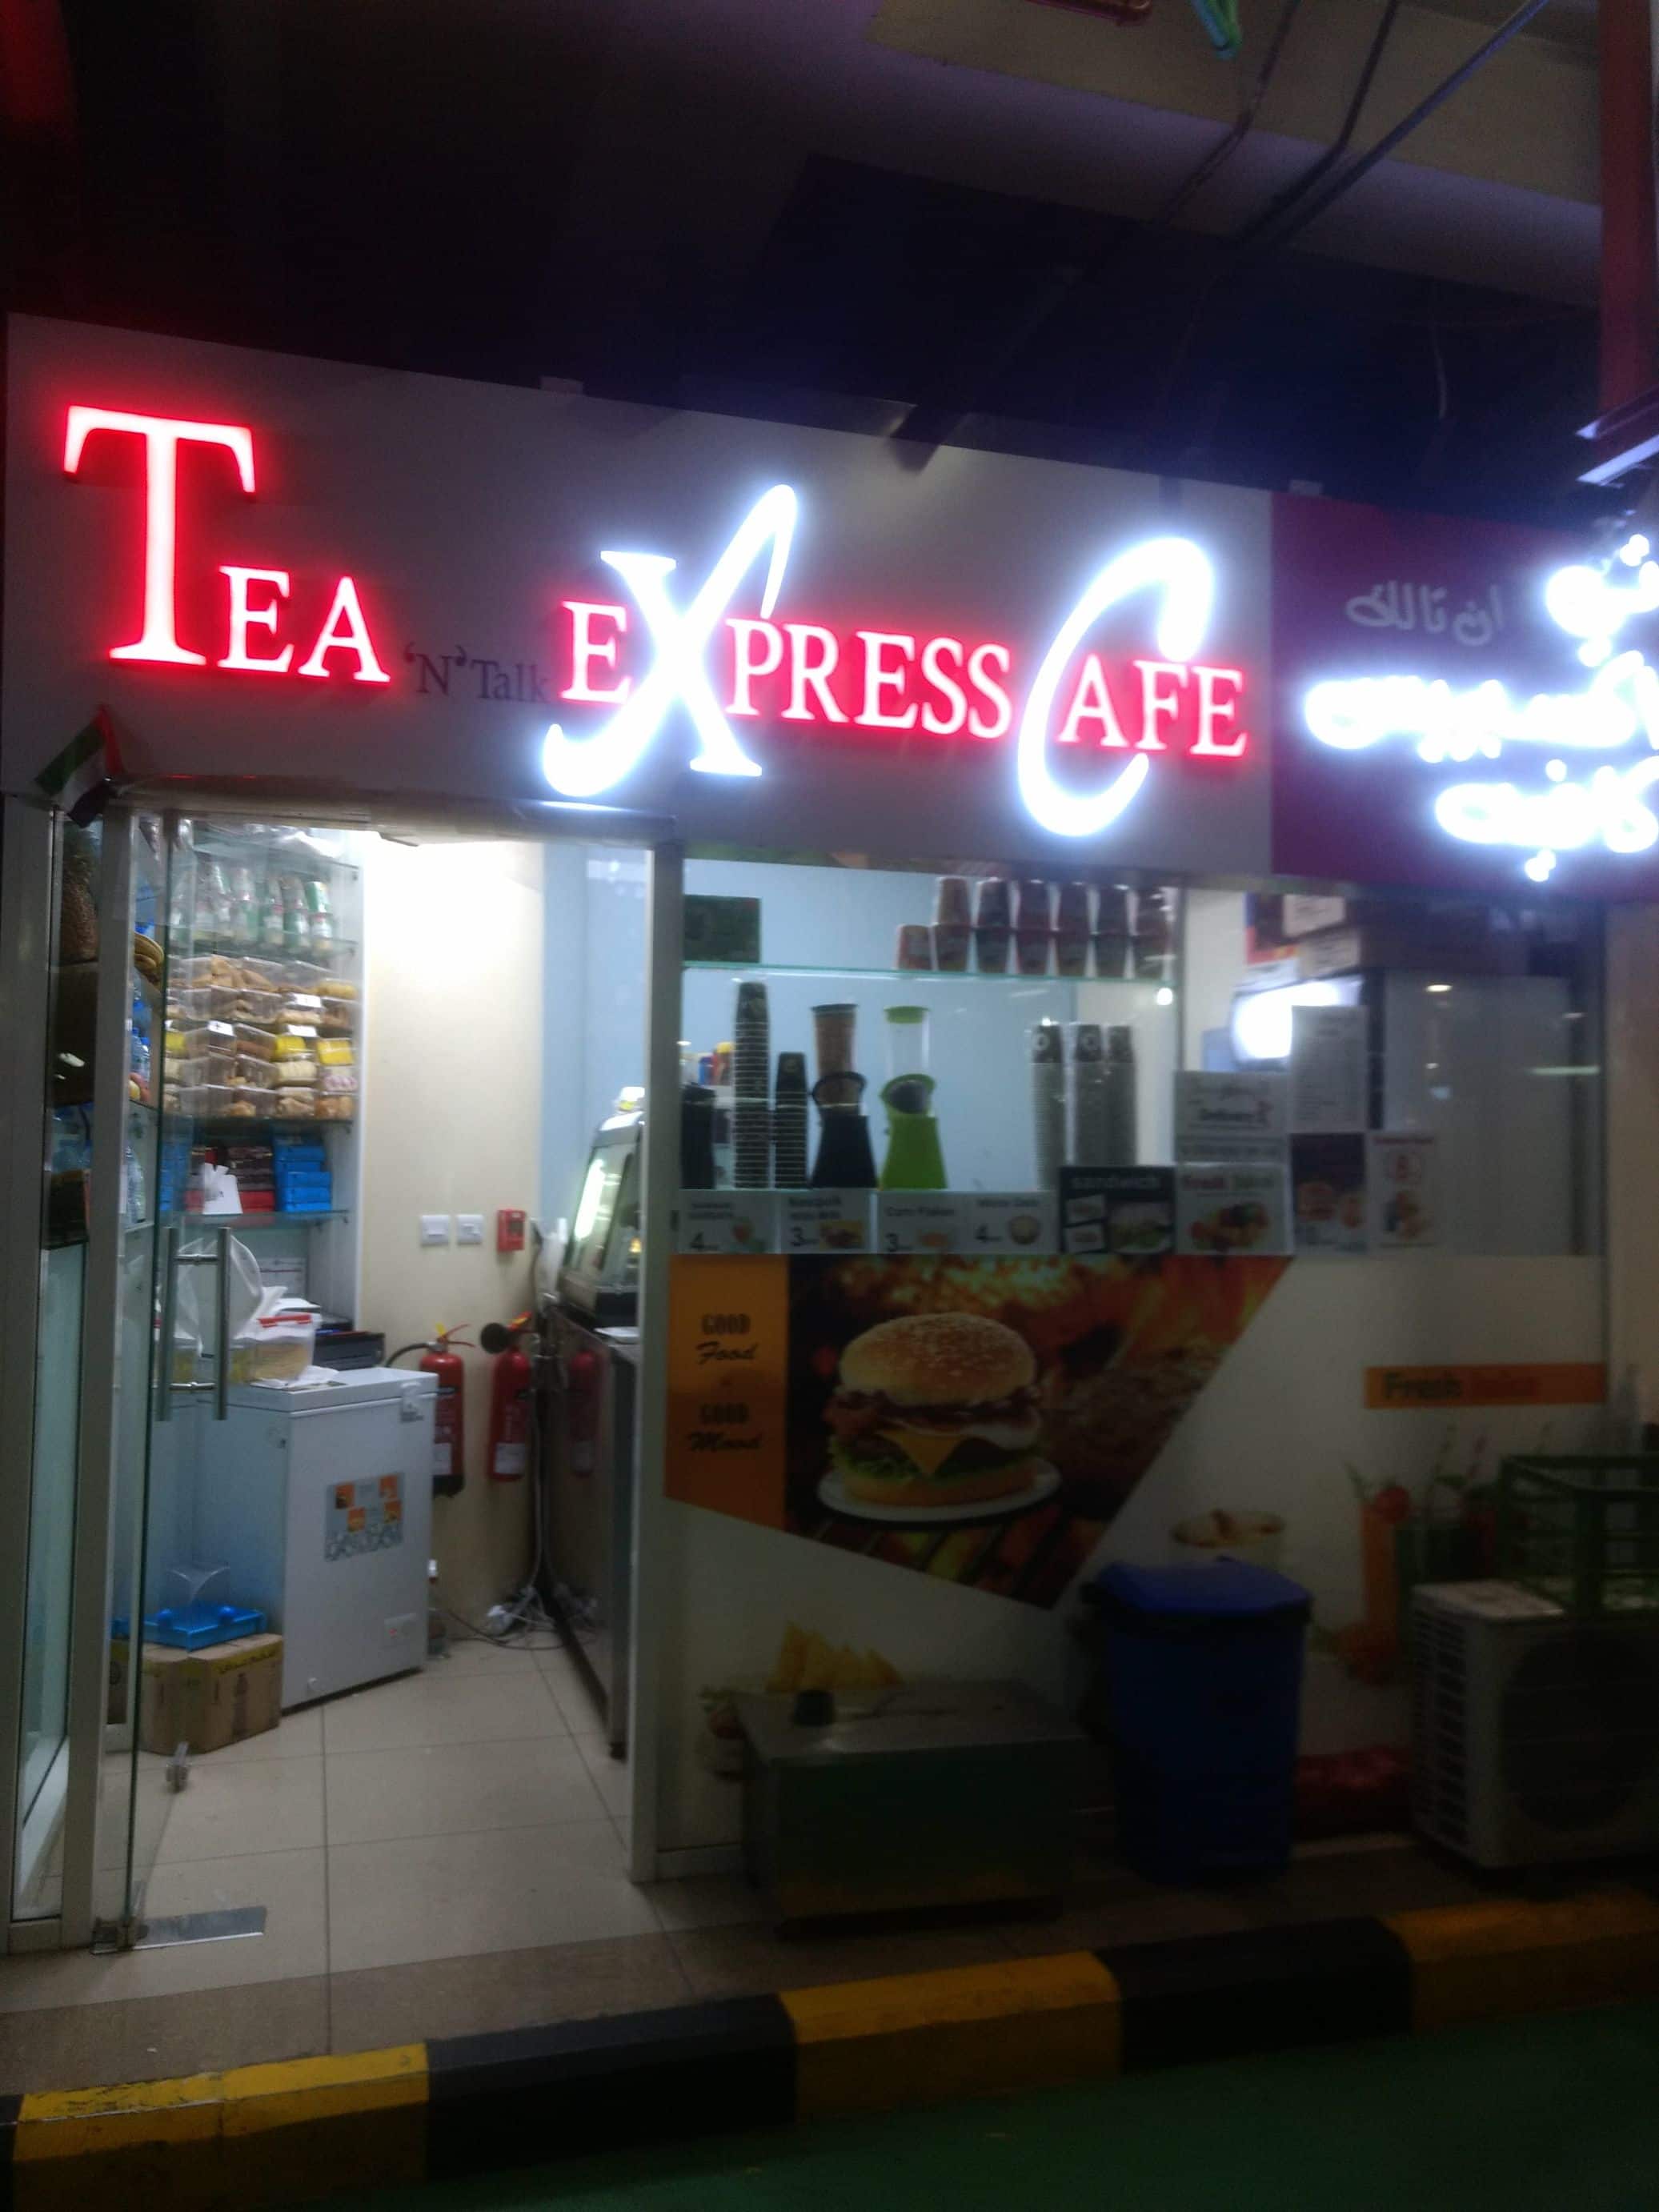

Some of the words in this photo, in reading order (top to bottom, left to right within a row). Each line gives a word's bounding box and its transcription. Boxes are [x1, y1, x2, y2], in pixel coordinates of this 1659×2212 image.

[62, 404, 391, 684] TEA
[469, 658, 551, 703] Talk
[542, 483, 1012, 799] EXPRESS
[1017, 535, 1248, 838] CAFE
